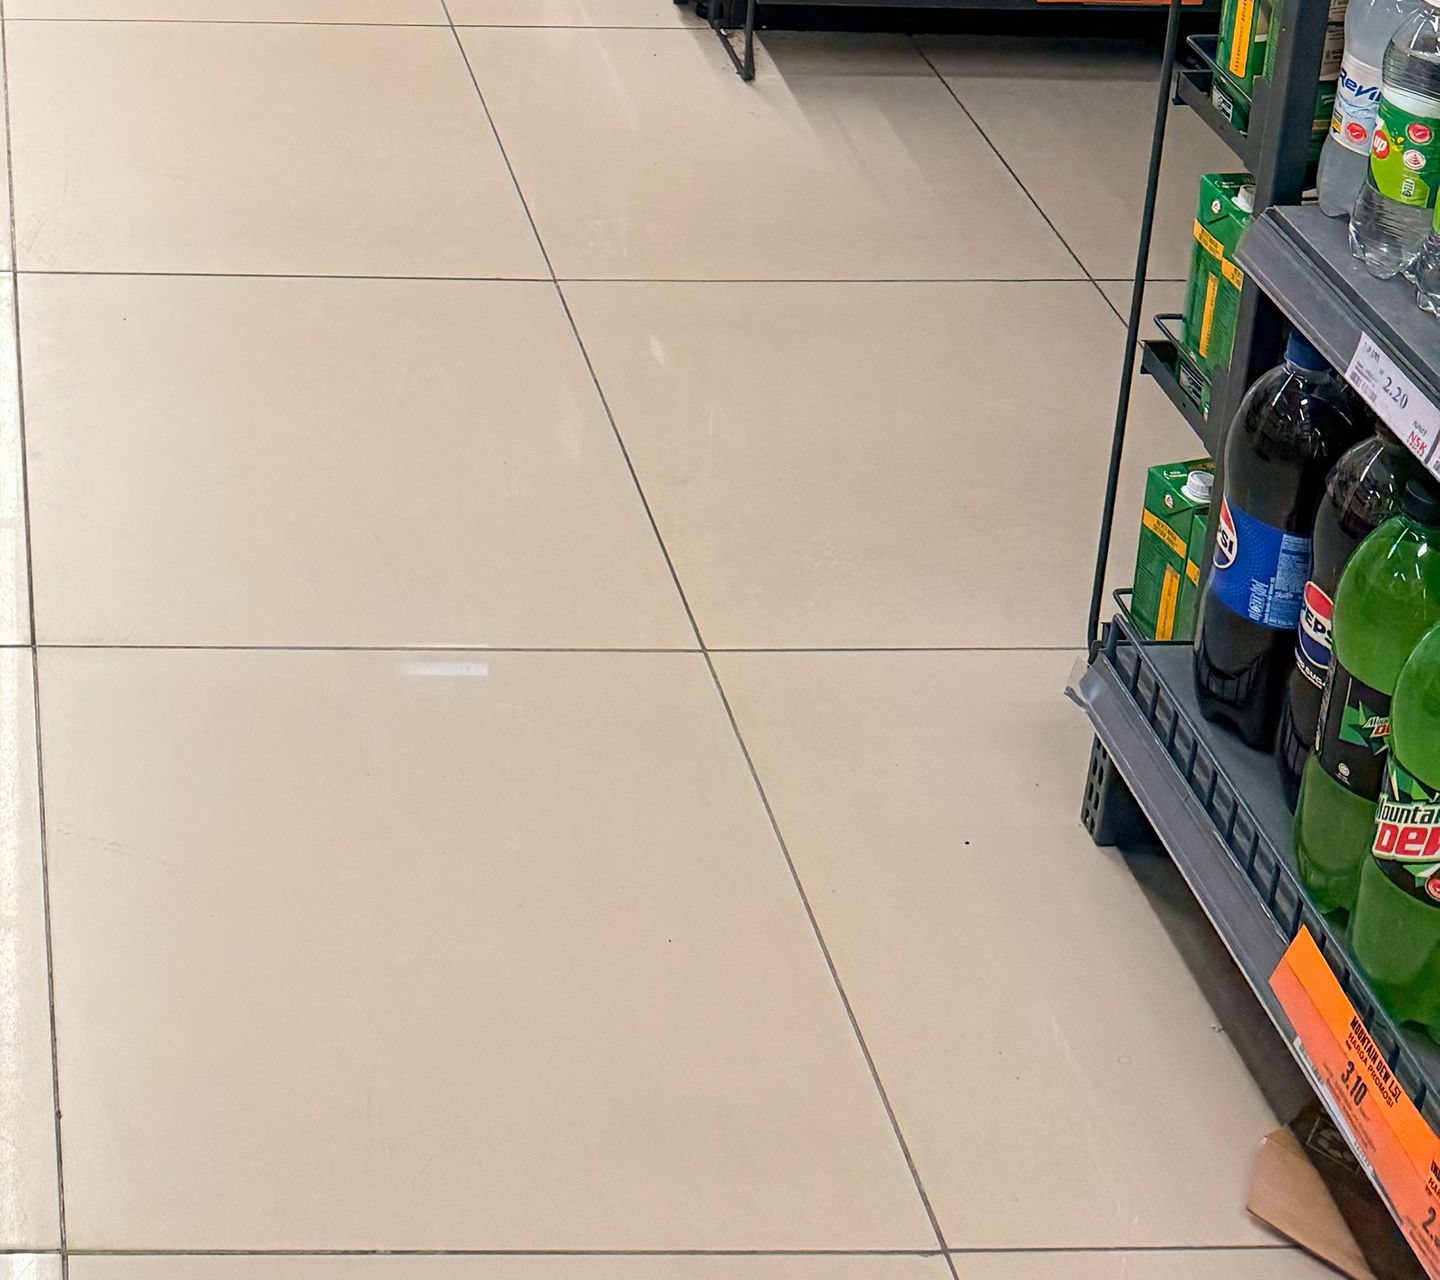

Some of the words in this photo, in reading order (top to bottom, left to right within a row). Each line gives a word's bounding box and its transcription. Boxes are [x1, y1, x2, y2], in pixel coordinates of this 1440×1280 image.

[1382, 374, 1410, 410] 2.20
[1348, 1031, 1369, 1066] HARGA
[1349, 1014, 1379, 1064] MOUNTAIN
[1375, 1057, 1392, 1082] DEW
[1340, 1060, 1369, 1107] 3.10
